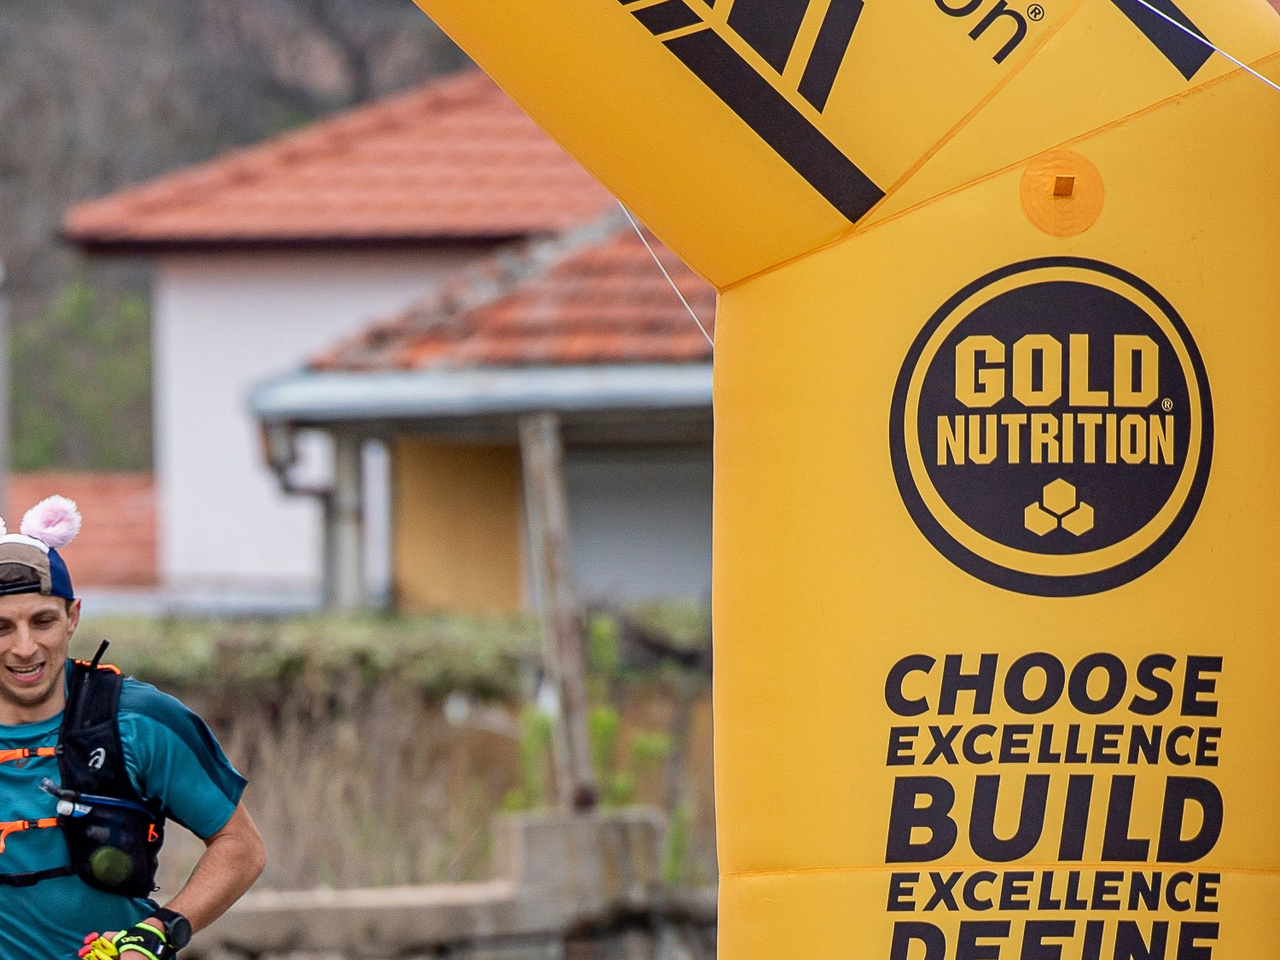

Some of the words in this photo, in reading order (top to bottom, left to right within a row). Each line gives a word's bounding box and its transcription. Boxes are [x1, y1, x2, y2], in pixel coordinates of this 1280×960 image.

[936, 413, 1175, 466] NUTRITION
[884, 652, 1223, 718] CHOOSE
[885, 723, 1222, 767] EXCELLENCE
[884, 773, 1224, 864] BUILD
[886, 870, 1221, 913] EXCELLENCE
